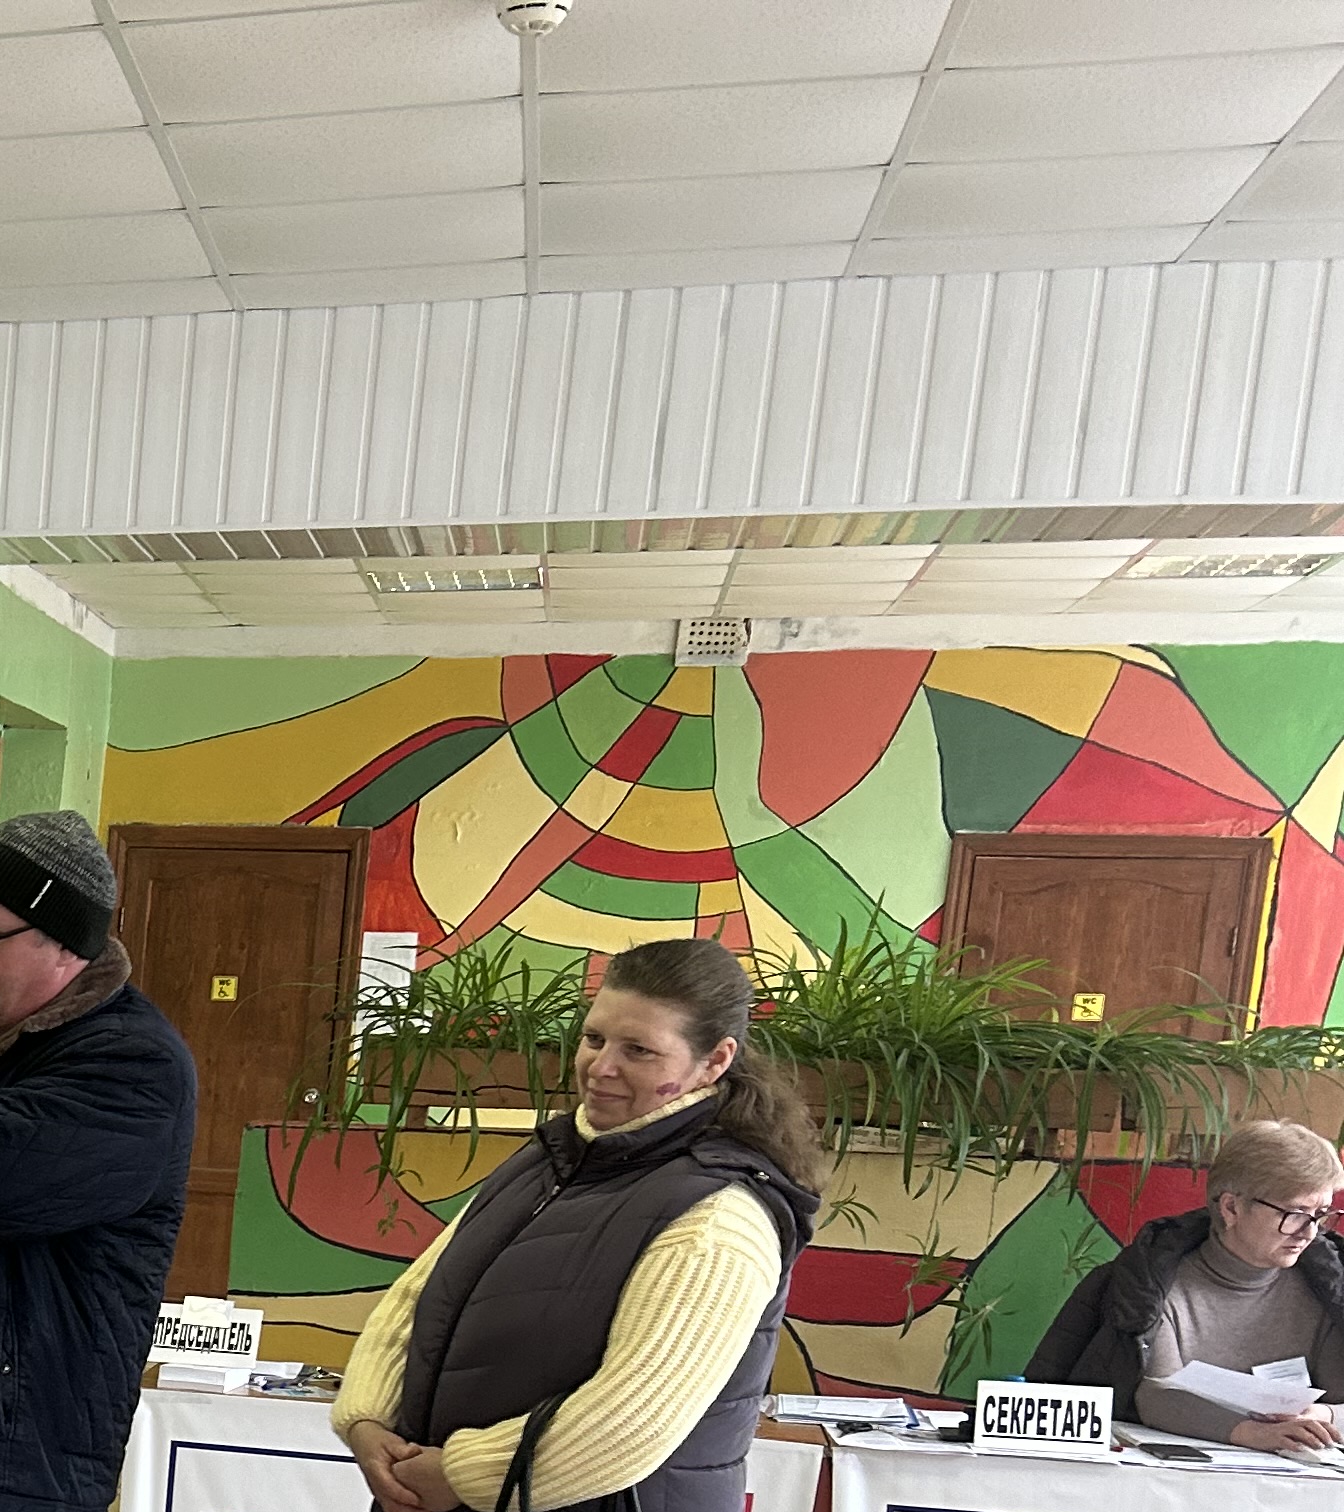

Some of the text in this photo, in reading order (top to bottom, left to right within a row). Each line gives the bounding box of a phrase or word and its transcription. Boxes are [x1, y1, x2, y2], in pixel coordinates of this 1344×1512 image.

[1082, 997, 1097, 1005] WC
[153, 1316, 252, 1354] ПРЕДСЕДАТЕЛЬ
[983, 1395, 1102, 1439] СЕКРЕТАРЬ
